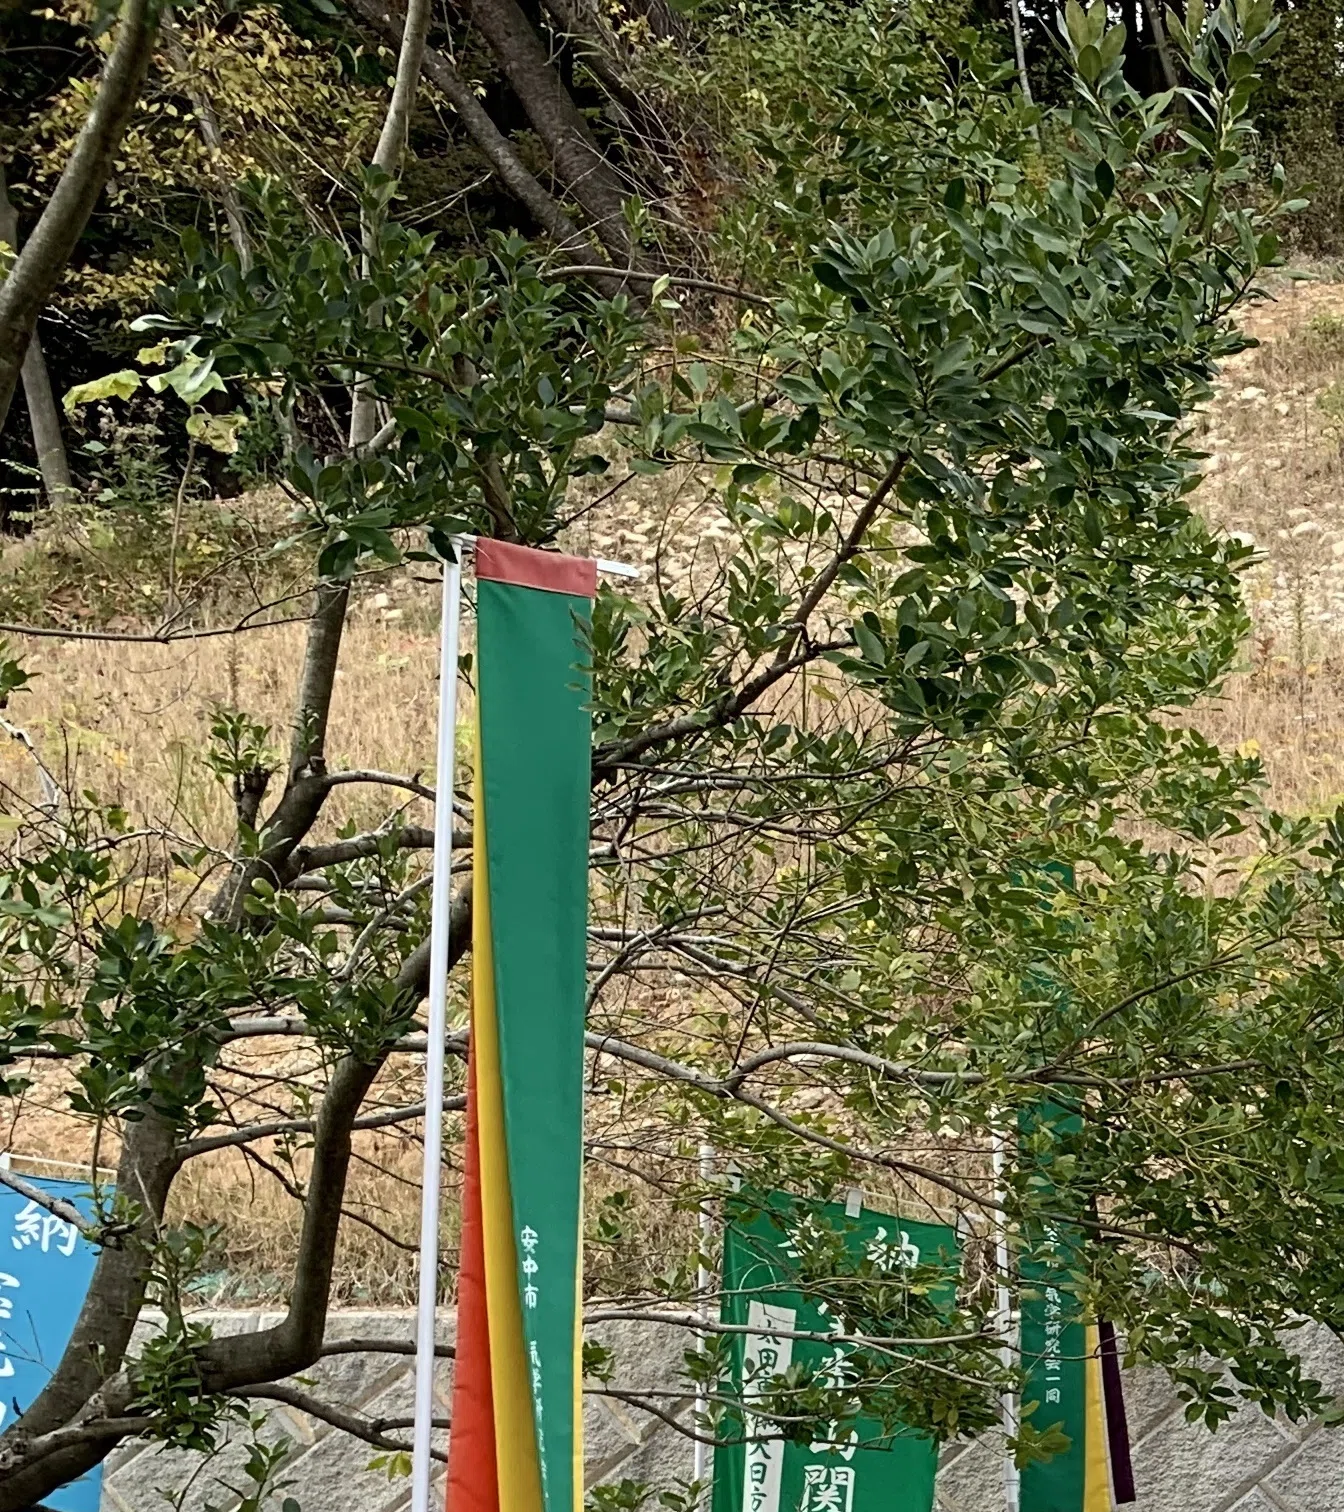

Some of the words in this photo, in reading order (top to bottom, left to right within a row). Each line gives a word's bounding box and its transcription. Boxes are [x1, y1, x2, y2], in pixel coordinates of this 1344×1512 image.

[11, 1199, 79, 1257] 納
[520, 1225, 539, 1310] 安中市
